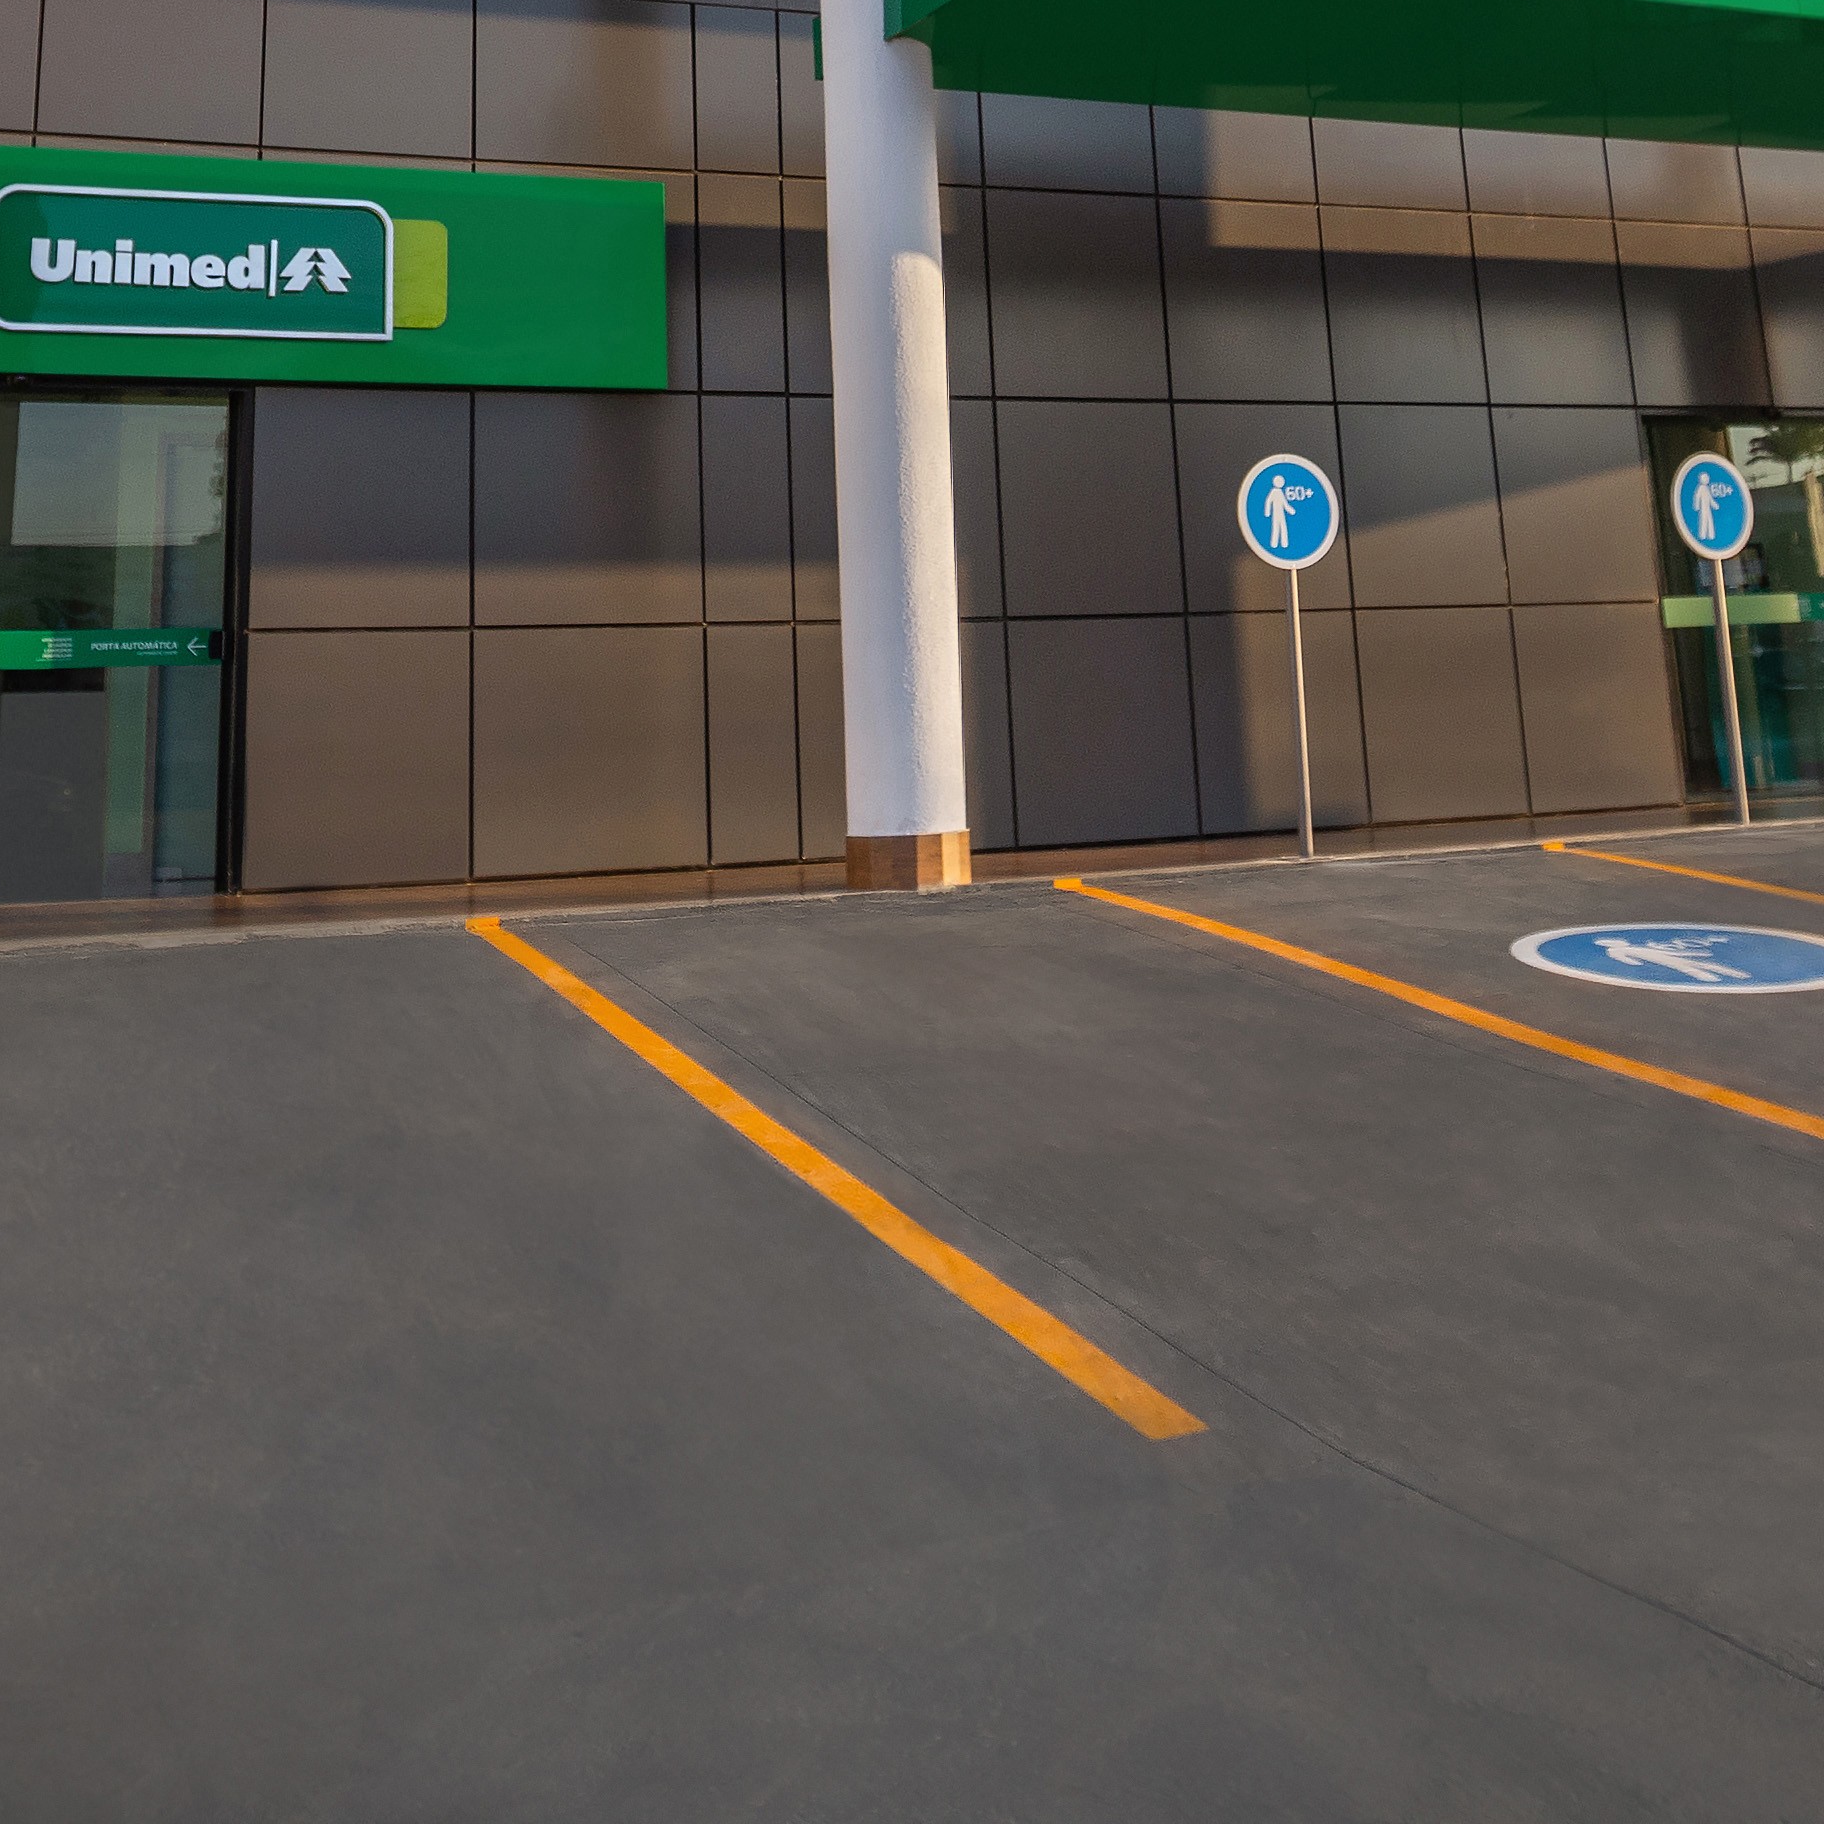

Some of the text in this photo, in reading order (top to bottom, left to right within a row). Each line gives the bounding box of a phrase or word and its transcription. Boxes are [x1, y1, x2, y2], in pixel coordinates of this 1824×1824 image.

[29, 237, 266, 291] Unimed
[1285, 485, 1314, 501] 60+
[90, 642, 119, 651] PORTA
